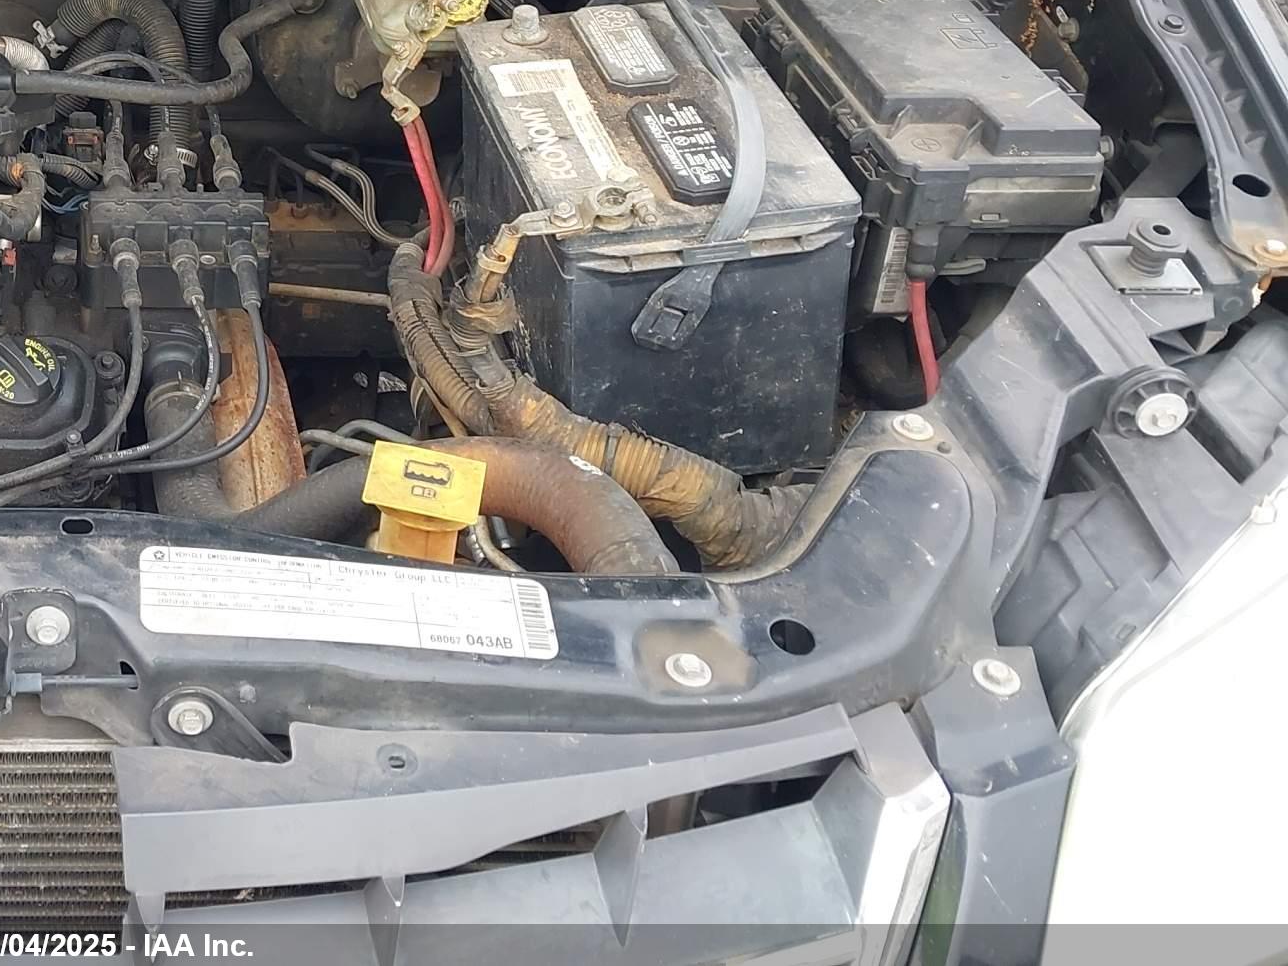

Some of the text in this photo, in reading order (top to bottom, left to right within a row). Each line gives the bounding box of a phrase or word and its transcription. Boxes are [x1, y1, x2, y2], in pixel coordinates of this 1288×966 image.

[508, 103, 578, 180] ECONOMY
[24, 338, 56, 372] ENGINE OIL
[175, 552, 203, 560] VEHICLE
[207, 554, 241, 562] EMISSION
[244, 557, 272, 565] CONTROL
[338, 565, 387, 578] Chrysler
[395, 572, 427, 584] Group
[431, 575, 451, 584] LLC
[429, 634, 513, 650] 68067 043AB
